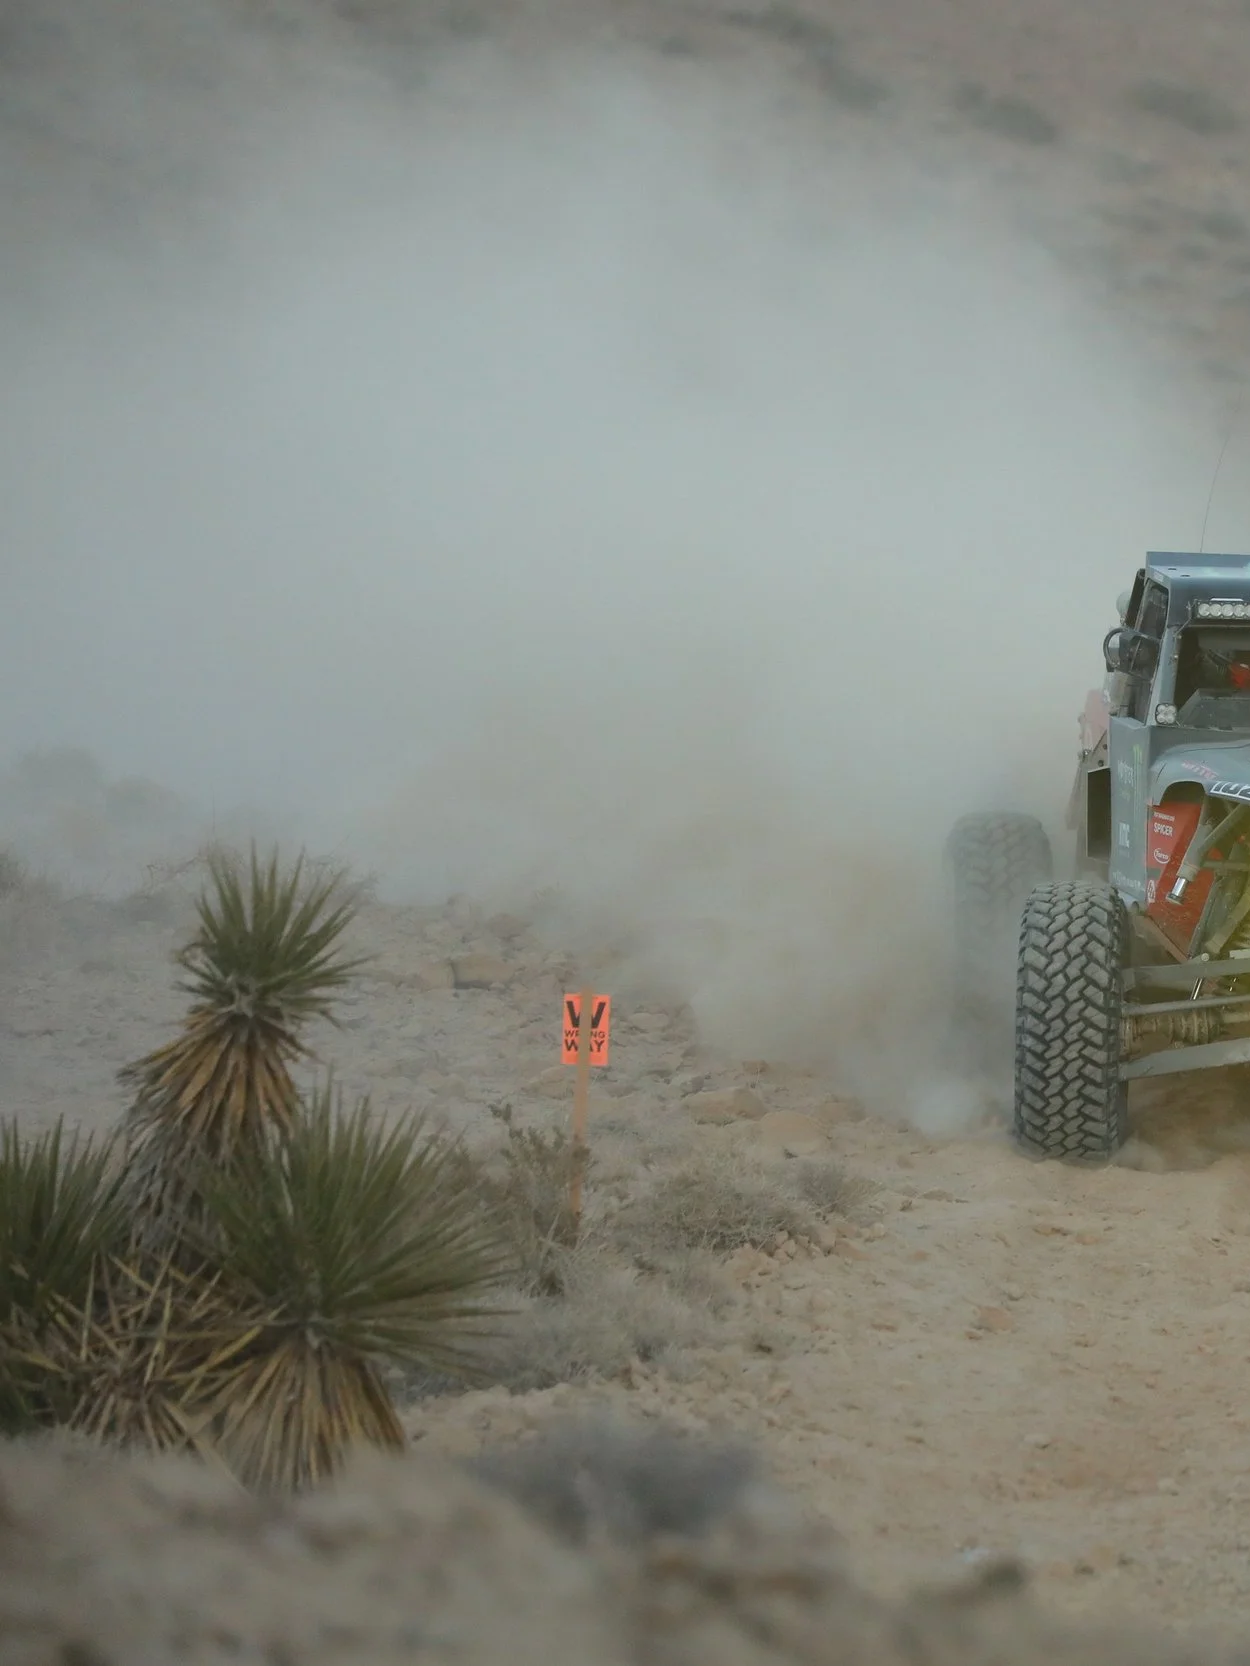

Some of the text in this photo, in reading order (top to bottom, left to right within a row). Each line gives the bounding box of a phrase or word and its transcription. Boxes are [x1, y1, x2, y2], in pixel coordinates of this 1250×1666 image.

[1153, 822, 1173, 837] SPICER
[566, 1001, 606, 1028] W
[564, 1030, 606, 1039] WRNG
